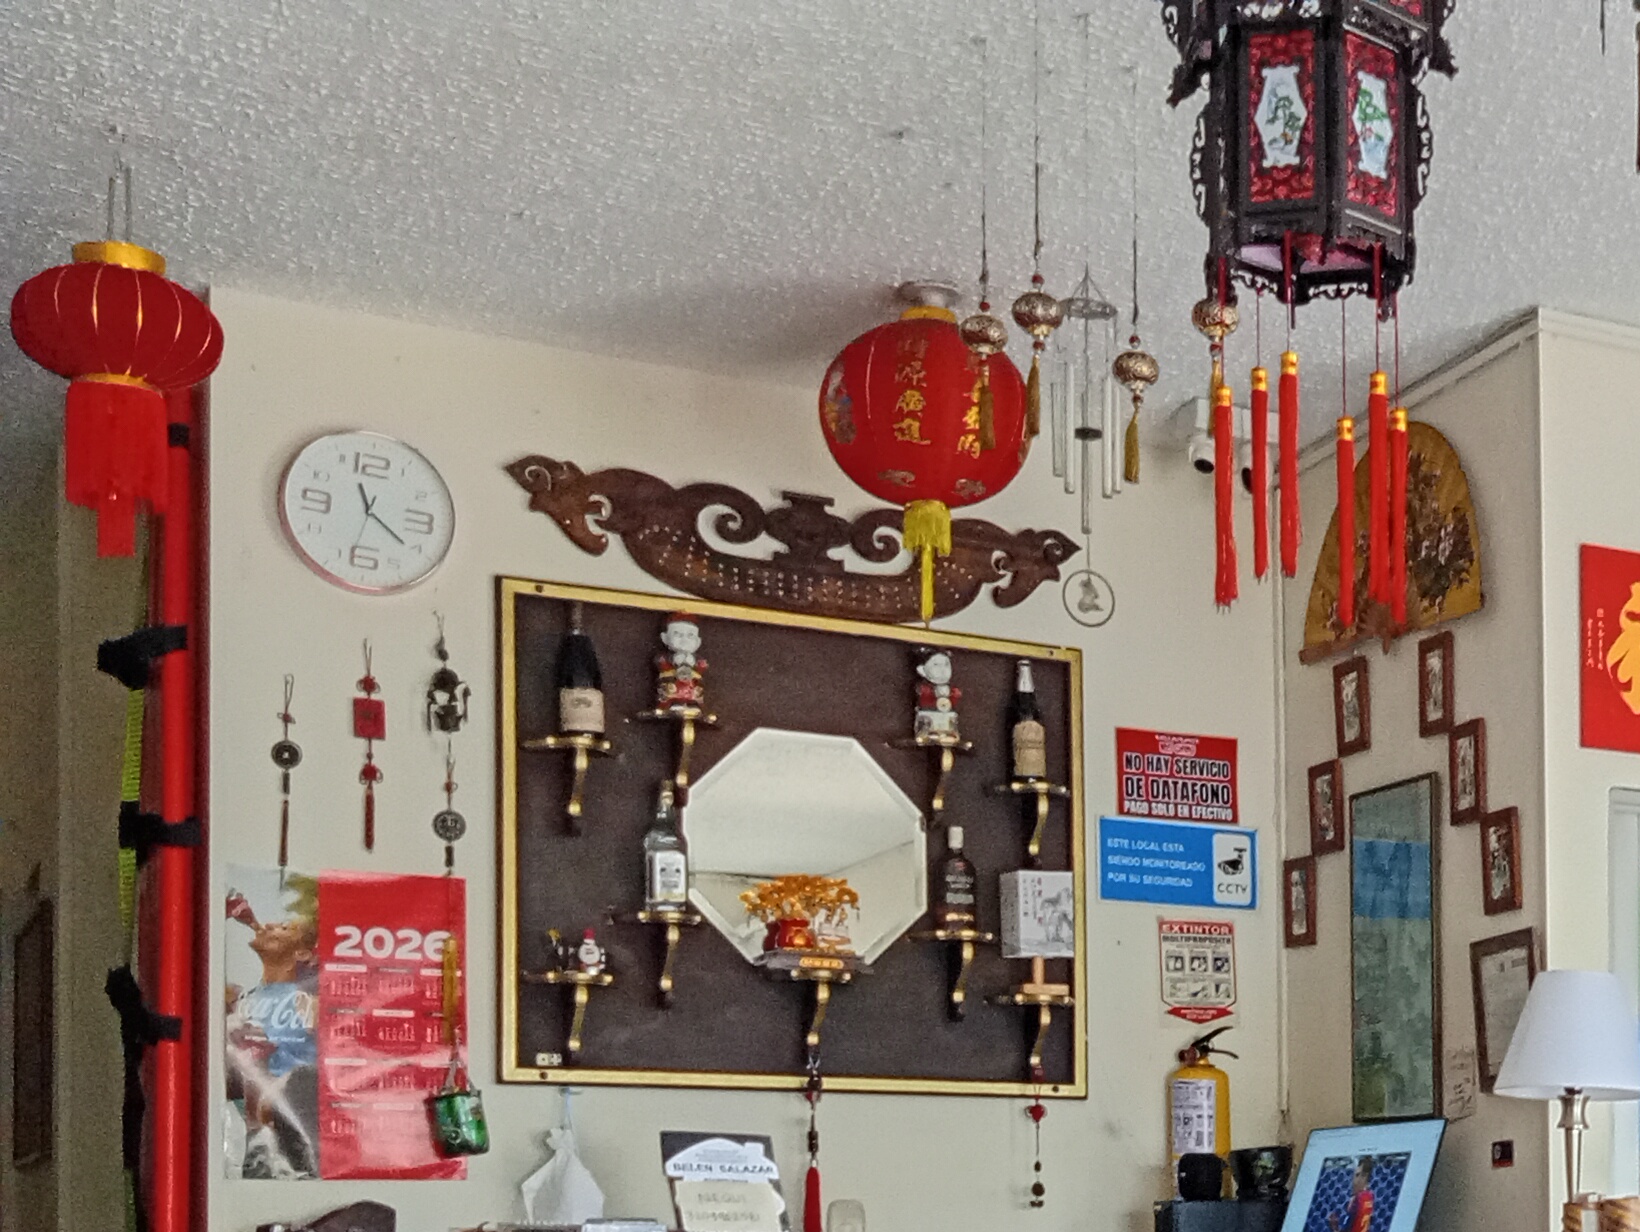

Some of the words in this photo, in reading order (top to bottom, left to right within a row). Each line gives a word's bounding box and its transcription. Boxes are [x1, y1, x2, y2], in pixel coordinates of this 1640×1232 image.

[353, 451, 391, 481] 12
[301, 487, 332, 515] 9
[405, 508, 434, 536] 3
[350, 545, 380, 571] 6
[1123, 752, 1143, 773] NO
[1145, 754, 1171, 775] HAY
[1173, 757, 1230, 781] SERVICIO
[1123, 775, 1145, 800] DE
[1149, 777, 1232, 807] DATAFONO
[1124, 800, 1149, 814] PAGO
[1151, 802, 1175, 816] SOLO
[1177, 804, 1190, 818] EN
[1191, 805, 1233, 821] EFECTIVO
[1107, 837, 1129, 849] ESTE
[1132, 839, 1160, 852] LOCAL
[1162, 842, 1184, 853] ESTA
[1107, 855, 1140, 867] SIENDO
[1107, 872, 1127, 883] POR
[1129, 873, 1141, 884] SU
[1143, 875, 1193, 888] SEGURIDAD
[1217, 882, 1248, 894] CCTV
[1162, 924, 1230, 935] EXTINTOR
[333, 925, 451, 963] 2026
[673, 1163, 713, 1173] BELEN
